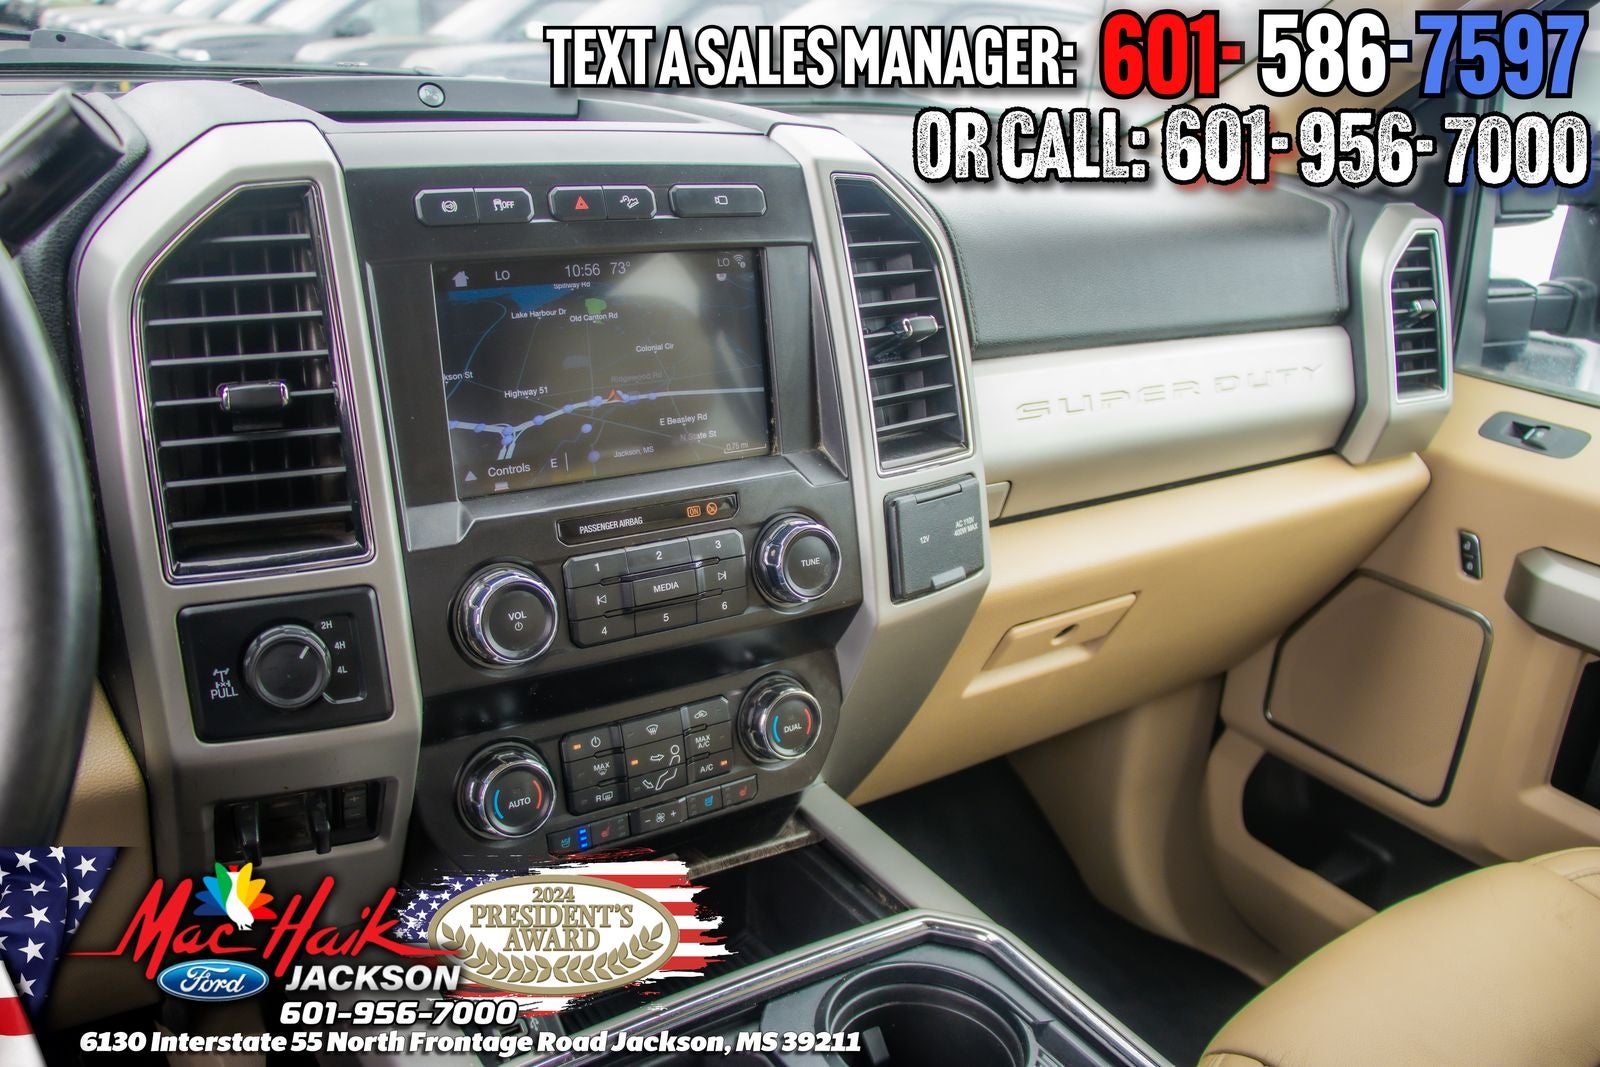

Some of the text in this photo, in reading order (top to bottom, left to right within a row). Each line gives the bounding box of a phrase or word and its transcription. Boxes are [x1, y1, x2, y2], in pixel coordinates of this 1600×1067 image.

[717, 257, 730, 267] LO
[495, 270, 511, 281] LO
[564, 263, 600, 278] 10:56
[511, 311, 528, 319] Lake
[529, 309, 556, 317] Harbour
[583, 313, 607, 322] Canton
[635, 342, 674, 353] Colonial Cir
[464, 371, 474, 379] St
[504, 387, 548, 400] Highway 51
[1015, 362, 1325, 421] SUPER DUTY
[659, 413, 708, 426] E Beasley Rd
[688, 431, 708, 441] State
[709, 430, 717, 438] St
[550, 458, 558, 468] E
[487, 463, 532, 478] Controls
[579, 516, 643, 534] PASSENGER AIRBAG
[715, 540, 722, 549] 3
[920, 535, 931, 544] 12V
[655, 551, 663, 560] 2
[801, 557, 821, 567] TUNE
[594, 563, 600, 572] 1
[653, 581, 680, 593] MEDIA
[721, 601, 728, 610] 6
[508, 611, 527, 620] VOL
[663, 613, 670, 622] 5
[321, 621, 333, 630] 2H
[601, 626, 608, 636] 4
[335, 641, 346, 650] 4H
[337, 666, 348, 674] 4L
[211, 687, 239, 700] PULL
[783, 722, 802, 733] DUAL
[695, 735, 710, 744] MAX
[593, 761, 610, 772] MAX
[700, 764, 714, 773] A/C
[508, 796, 531, 810] AUTO
